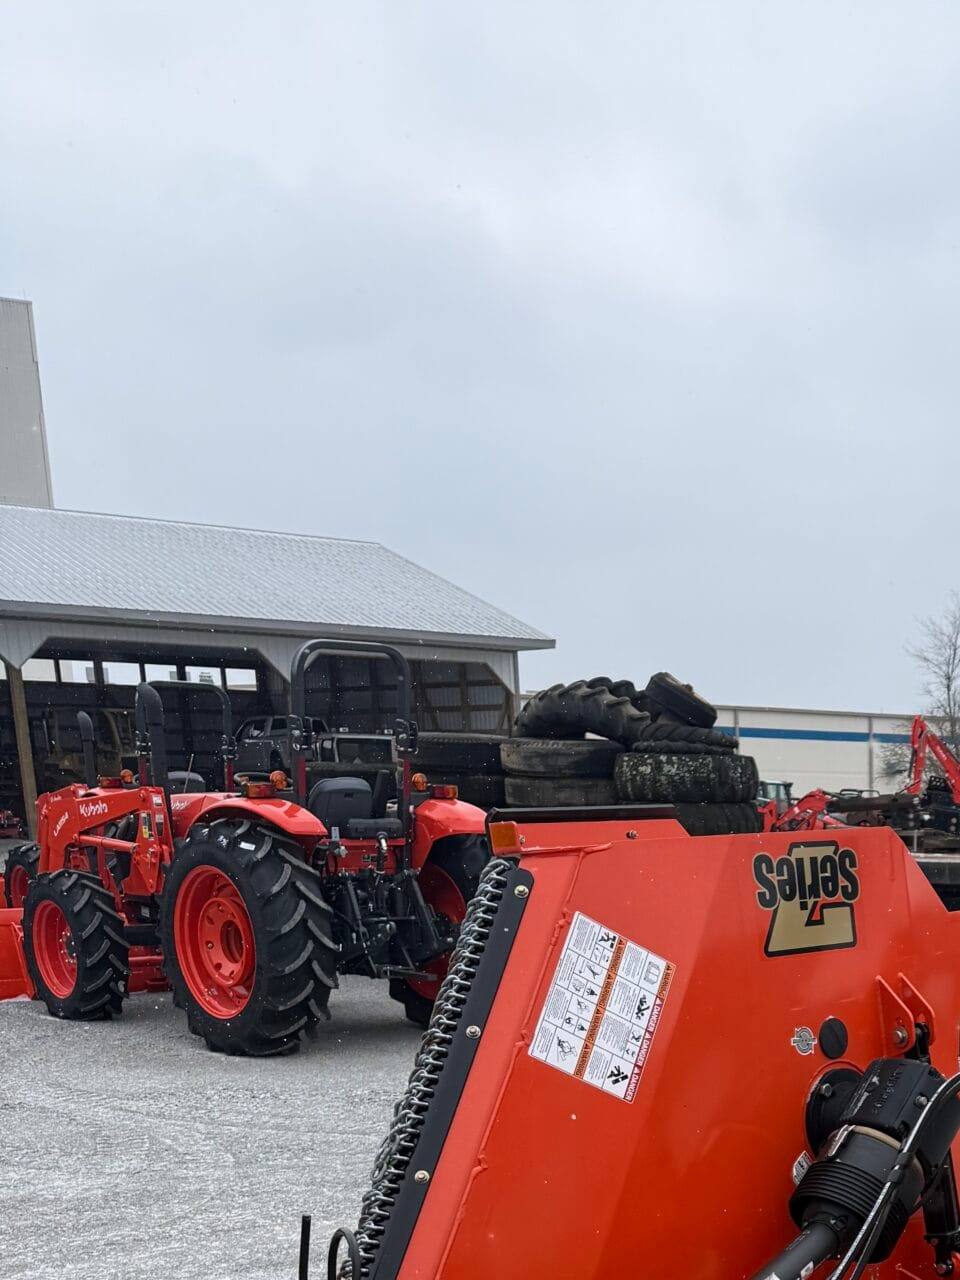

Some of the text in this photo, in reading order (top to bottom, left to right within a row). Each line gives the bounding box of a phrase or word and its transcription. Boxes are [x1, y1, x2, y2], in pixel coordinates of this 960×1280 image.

[79, 800, 108, 818] Kubota
[647, 1005, 661, 1032] DANGER
[637, 1039, 651, 1067] DANGER
[625, 1074, 640, 1101] DANGER
